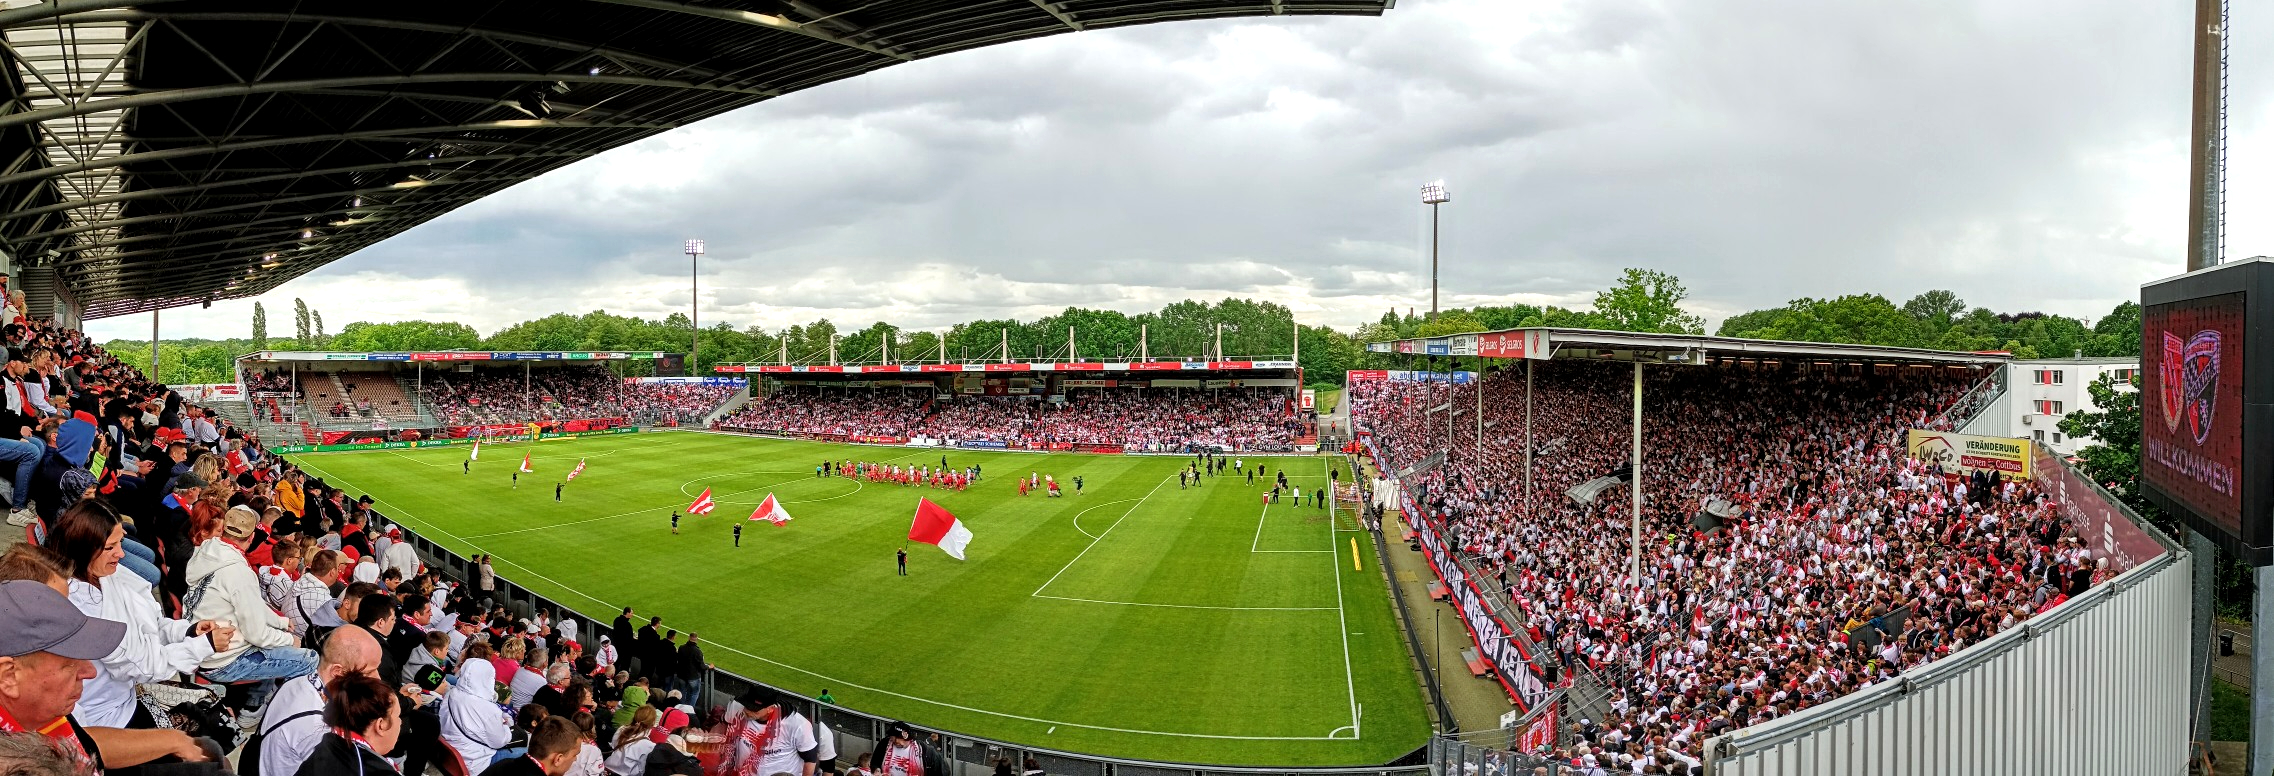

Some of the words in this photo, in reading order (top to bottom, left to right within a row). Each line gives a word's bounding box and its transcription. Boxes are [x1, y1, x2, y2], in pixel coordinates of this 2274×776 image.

[1966, 440, 2020, 454] VERÄNDERUNG
[1995, 459, 2021, 470] Cottbus
[2148, 435, 2233, 497] WILLKOMMEN
